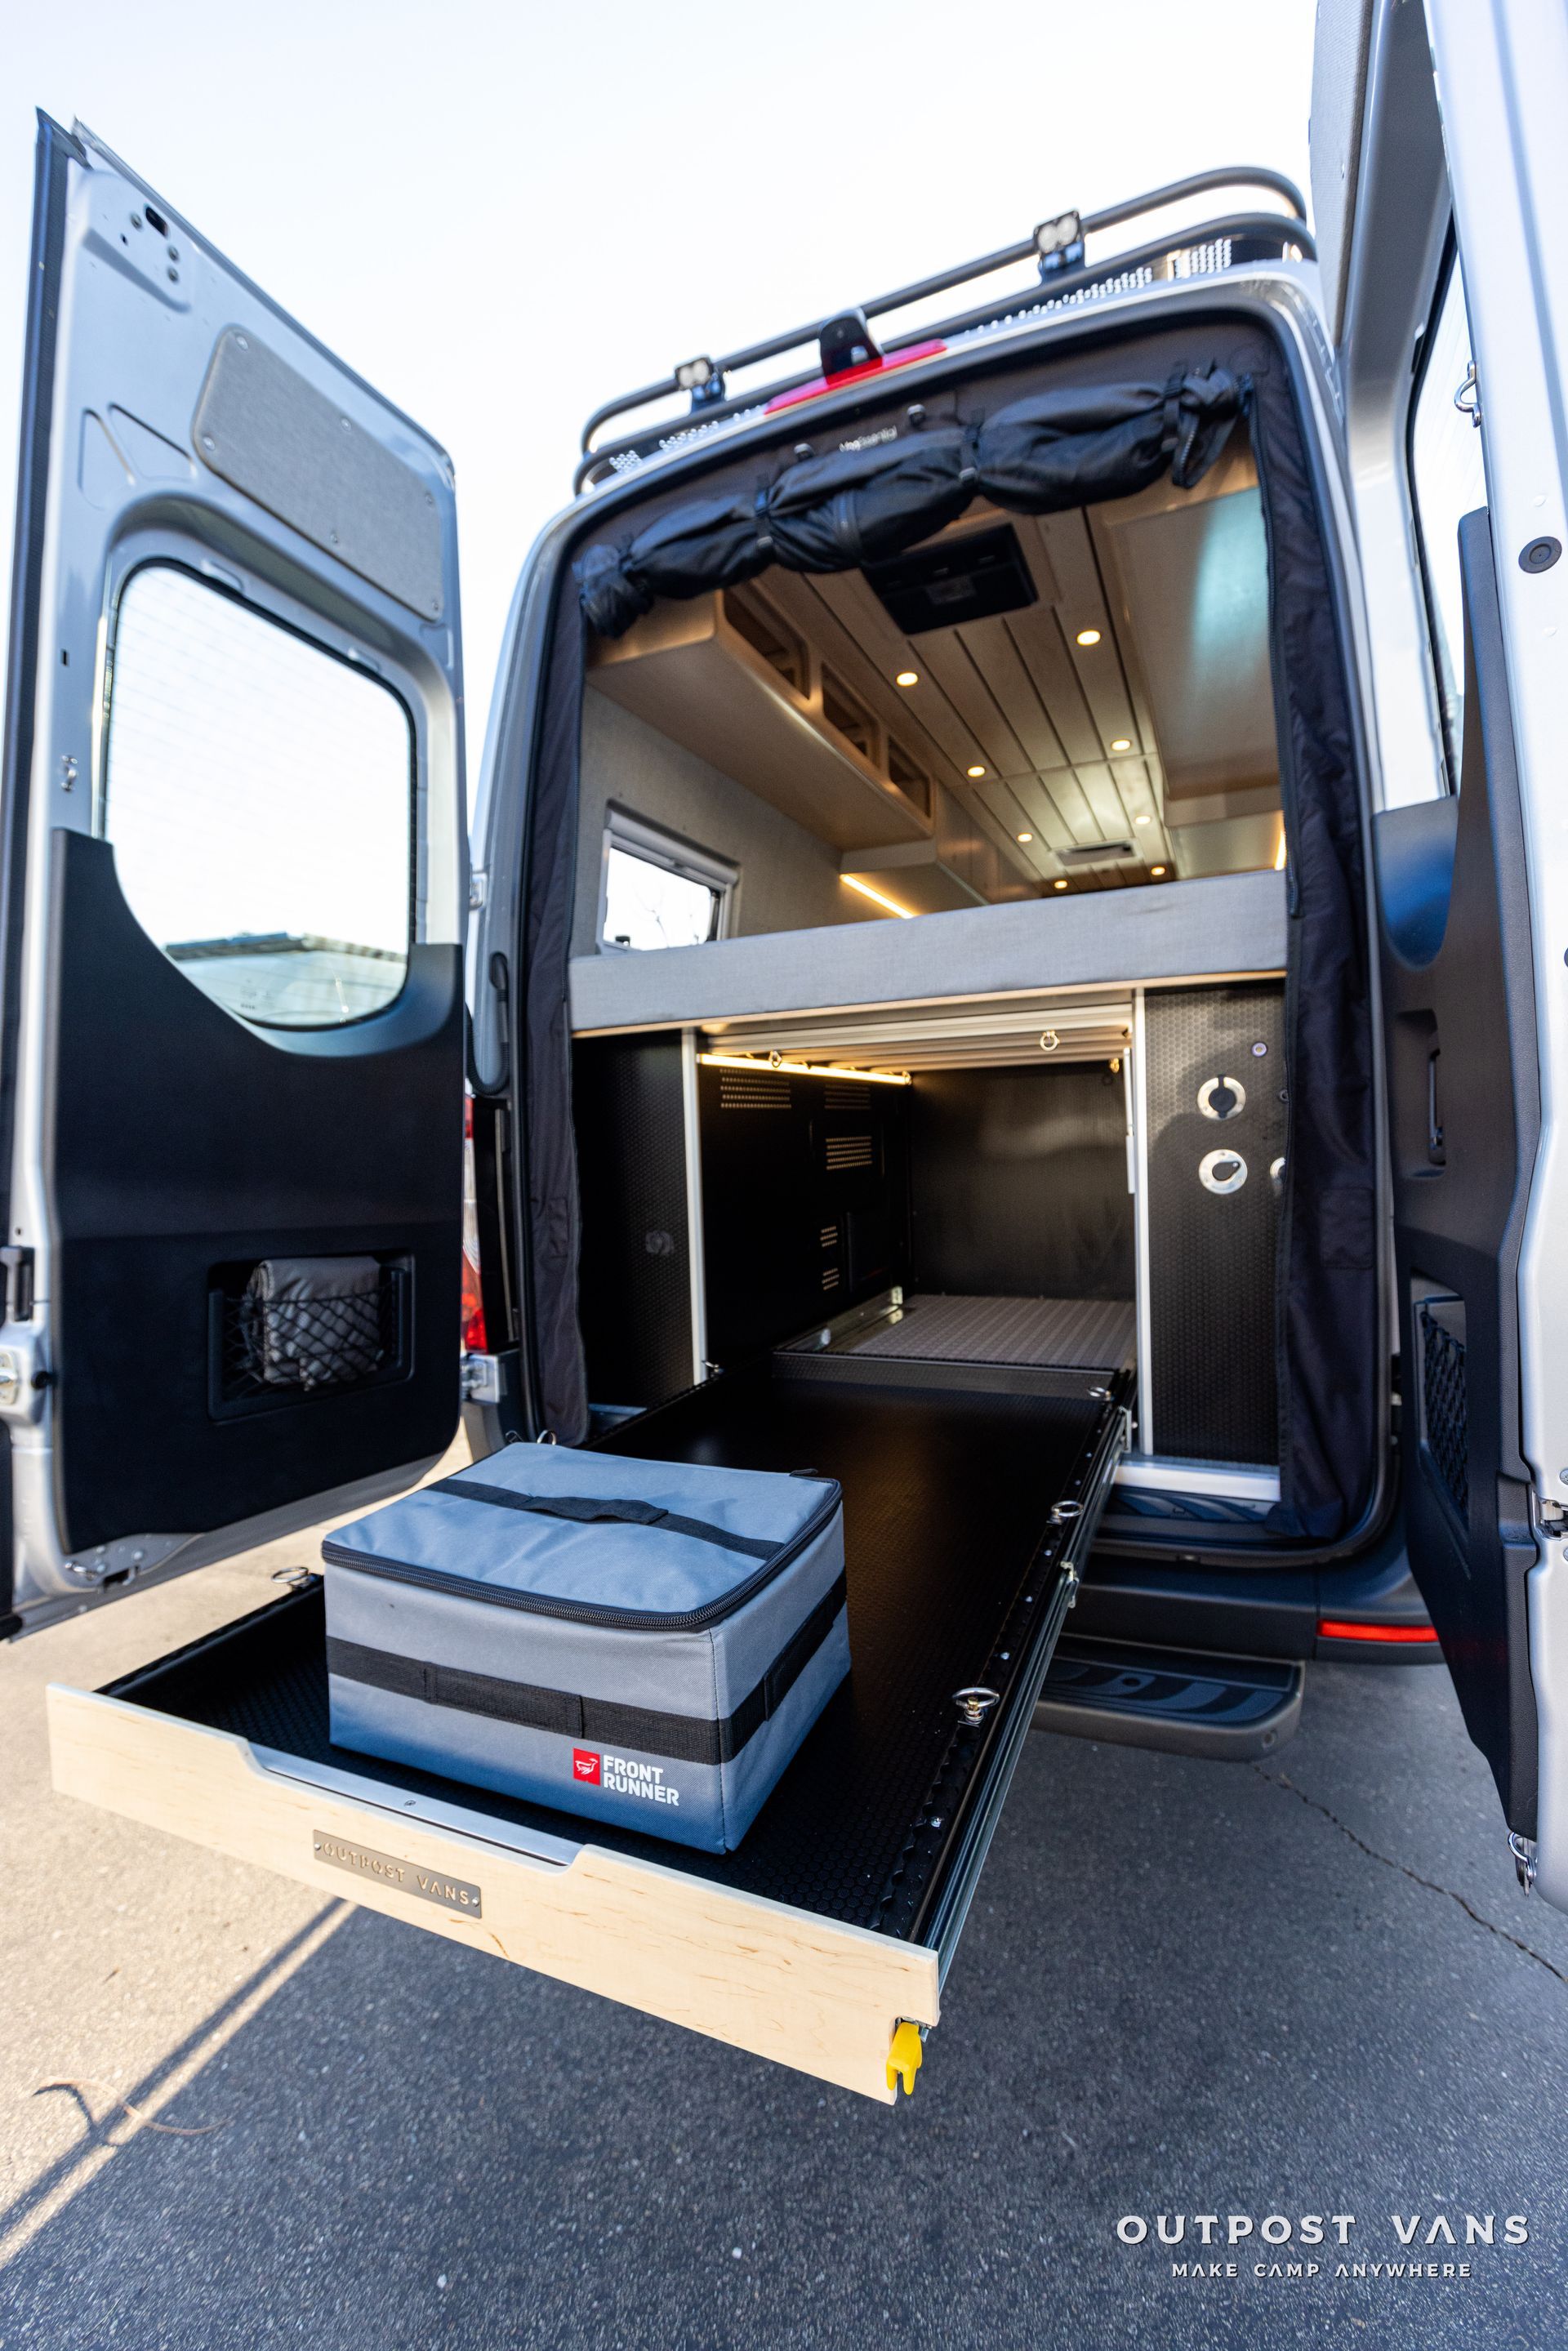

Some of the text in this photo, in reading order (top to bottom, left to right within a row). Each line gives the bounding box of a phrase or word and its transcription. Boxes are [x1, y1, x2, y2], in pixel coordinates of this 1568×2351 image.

[604, 1754, 664, 1784] FRONT
[604, 1772, 679, 1806] RUNNER
[323, 1842, 470, 1905] OUTPOST VANS
